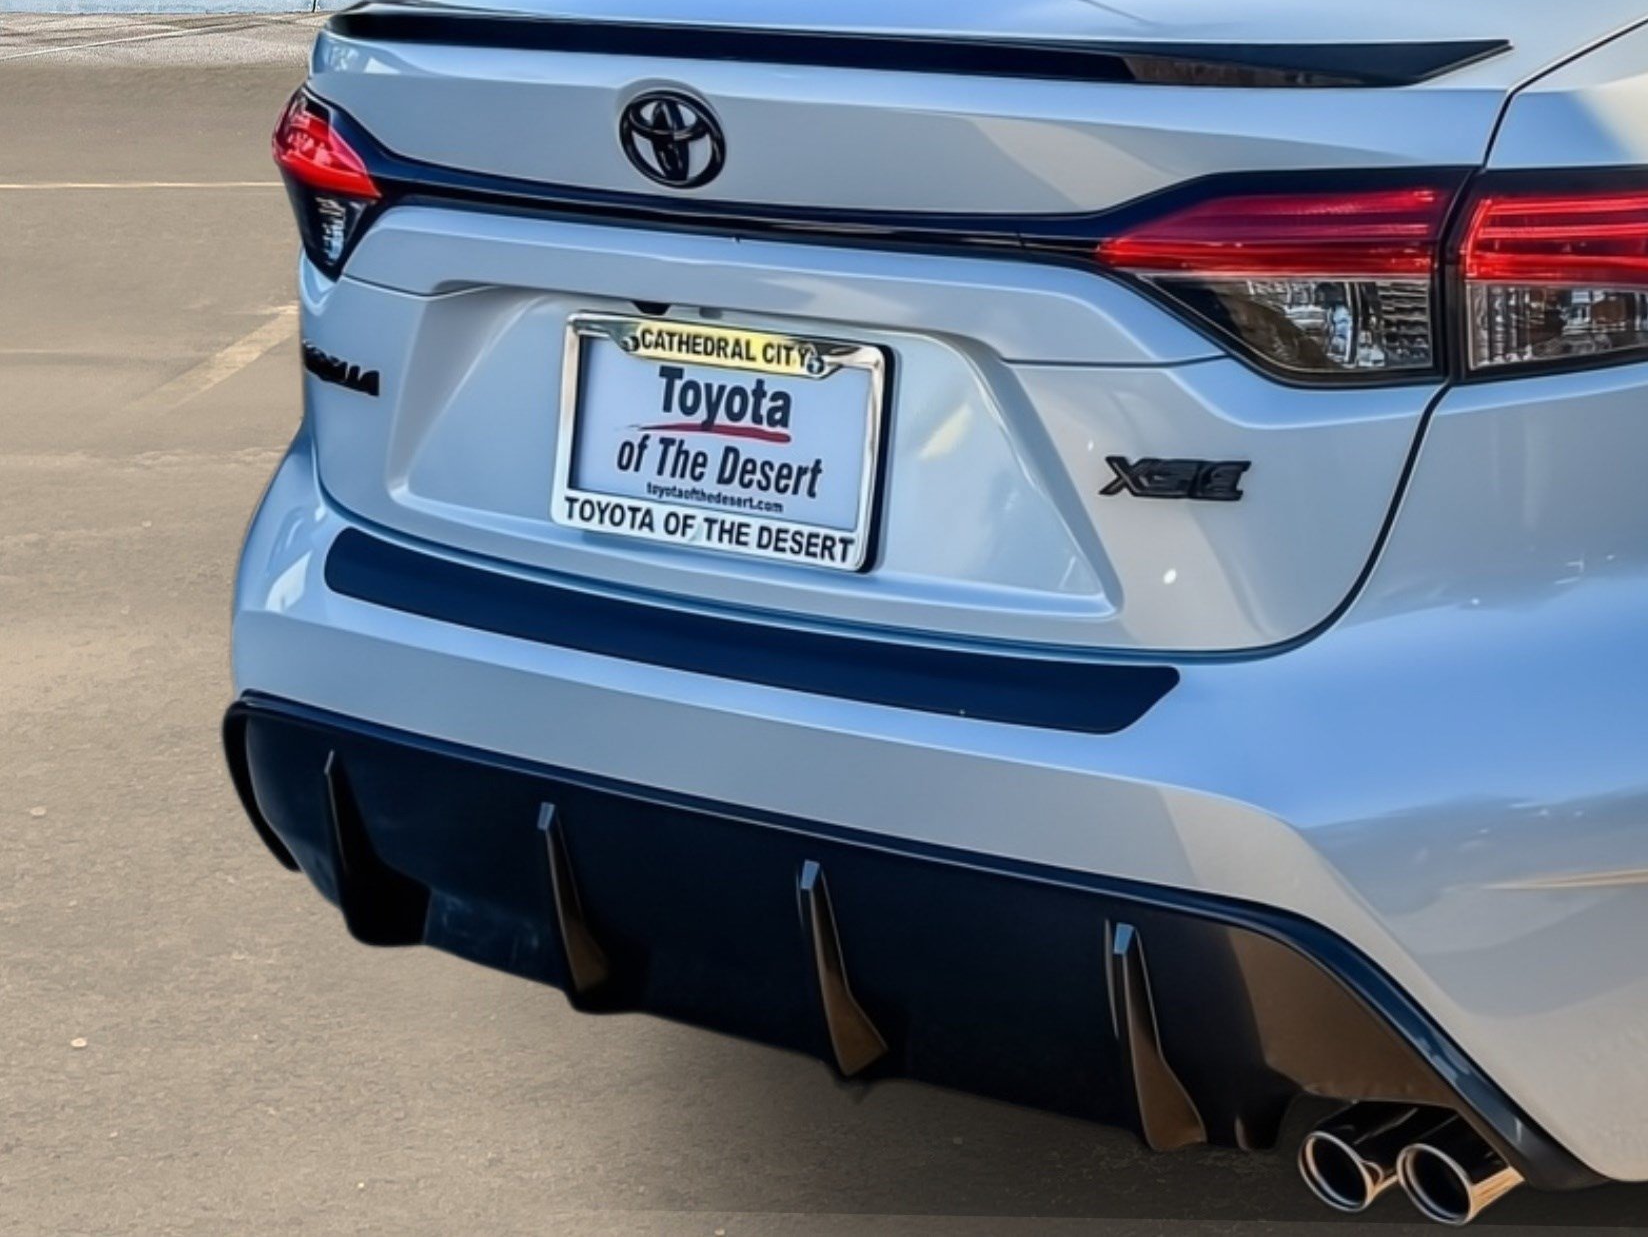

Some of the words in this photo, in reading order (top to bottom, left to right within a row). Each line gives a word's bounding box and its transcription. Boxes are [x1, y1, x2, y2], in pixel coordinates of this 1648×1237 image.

[640, 328, 756, 362] CATHEDRAL
[762, 342, 809, 367] CITY
[659, 366, 791, 430] Toyota
[617, 434, 650, 472] of
[656, 438, 708, 485] The
[717, 445, 822, 498] Desert
[646, 482, 783, 513] toyotaofthedesert.com
[565, 496, 655, 533] TOYOTA
[663, 512, 696, 538] OF
[703, 517, 751, 547] THE
[757, 525, 854, 563] DESERT
